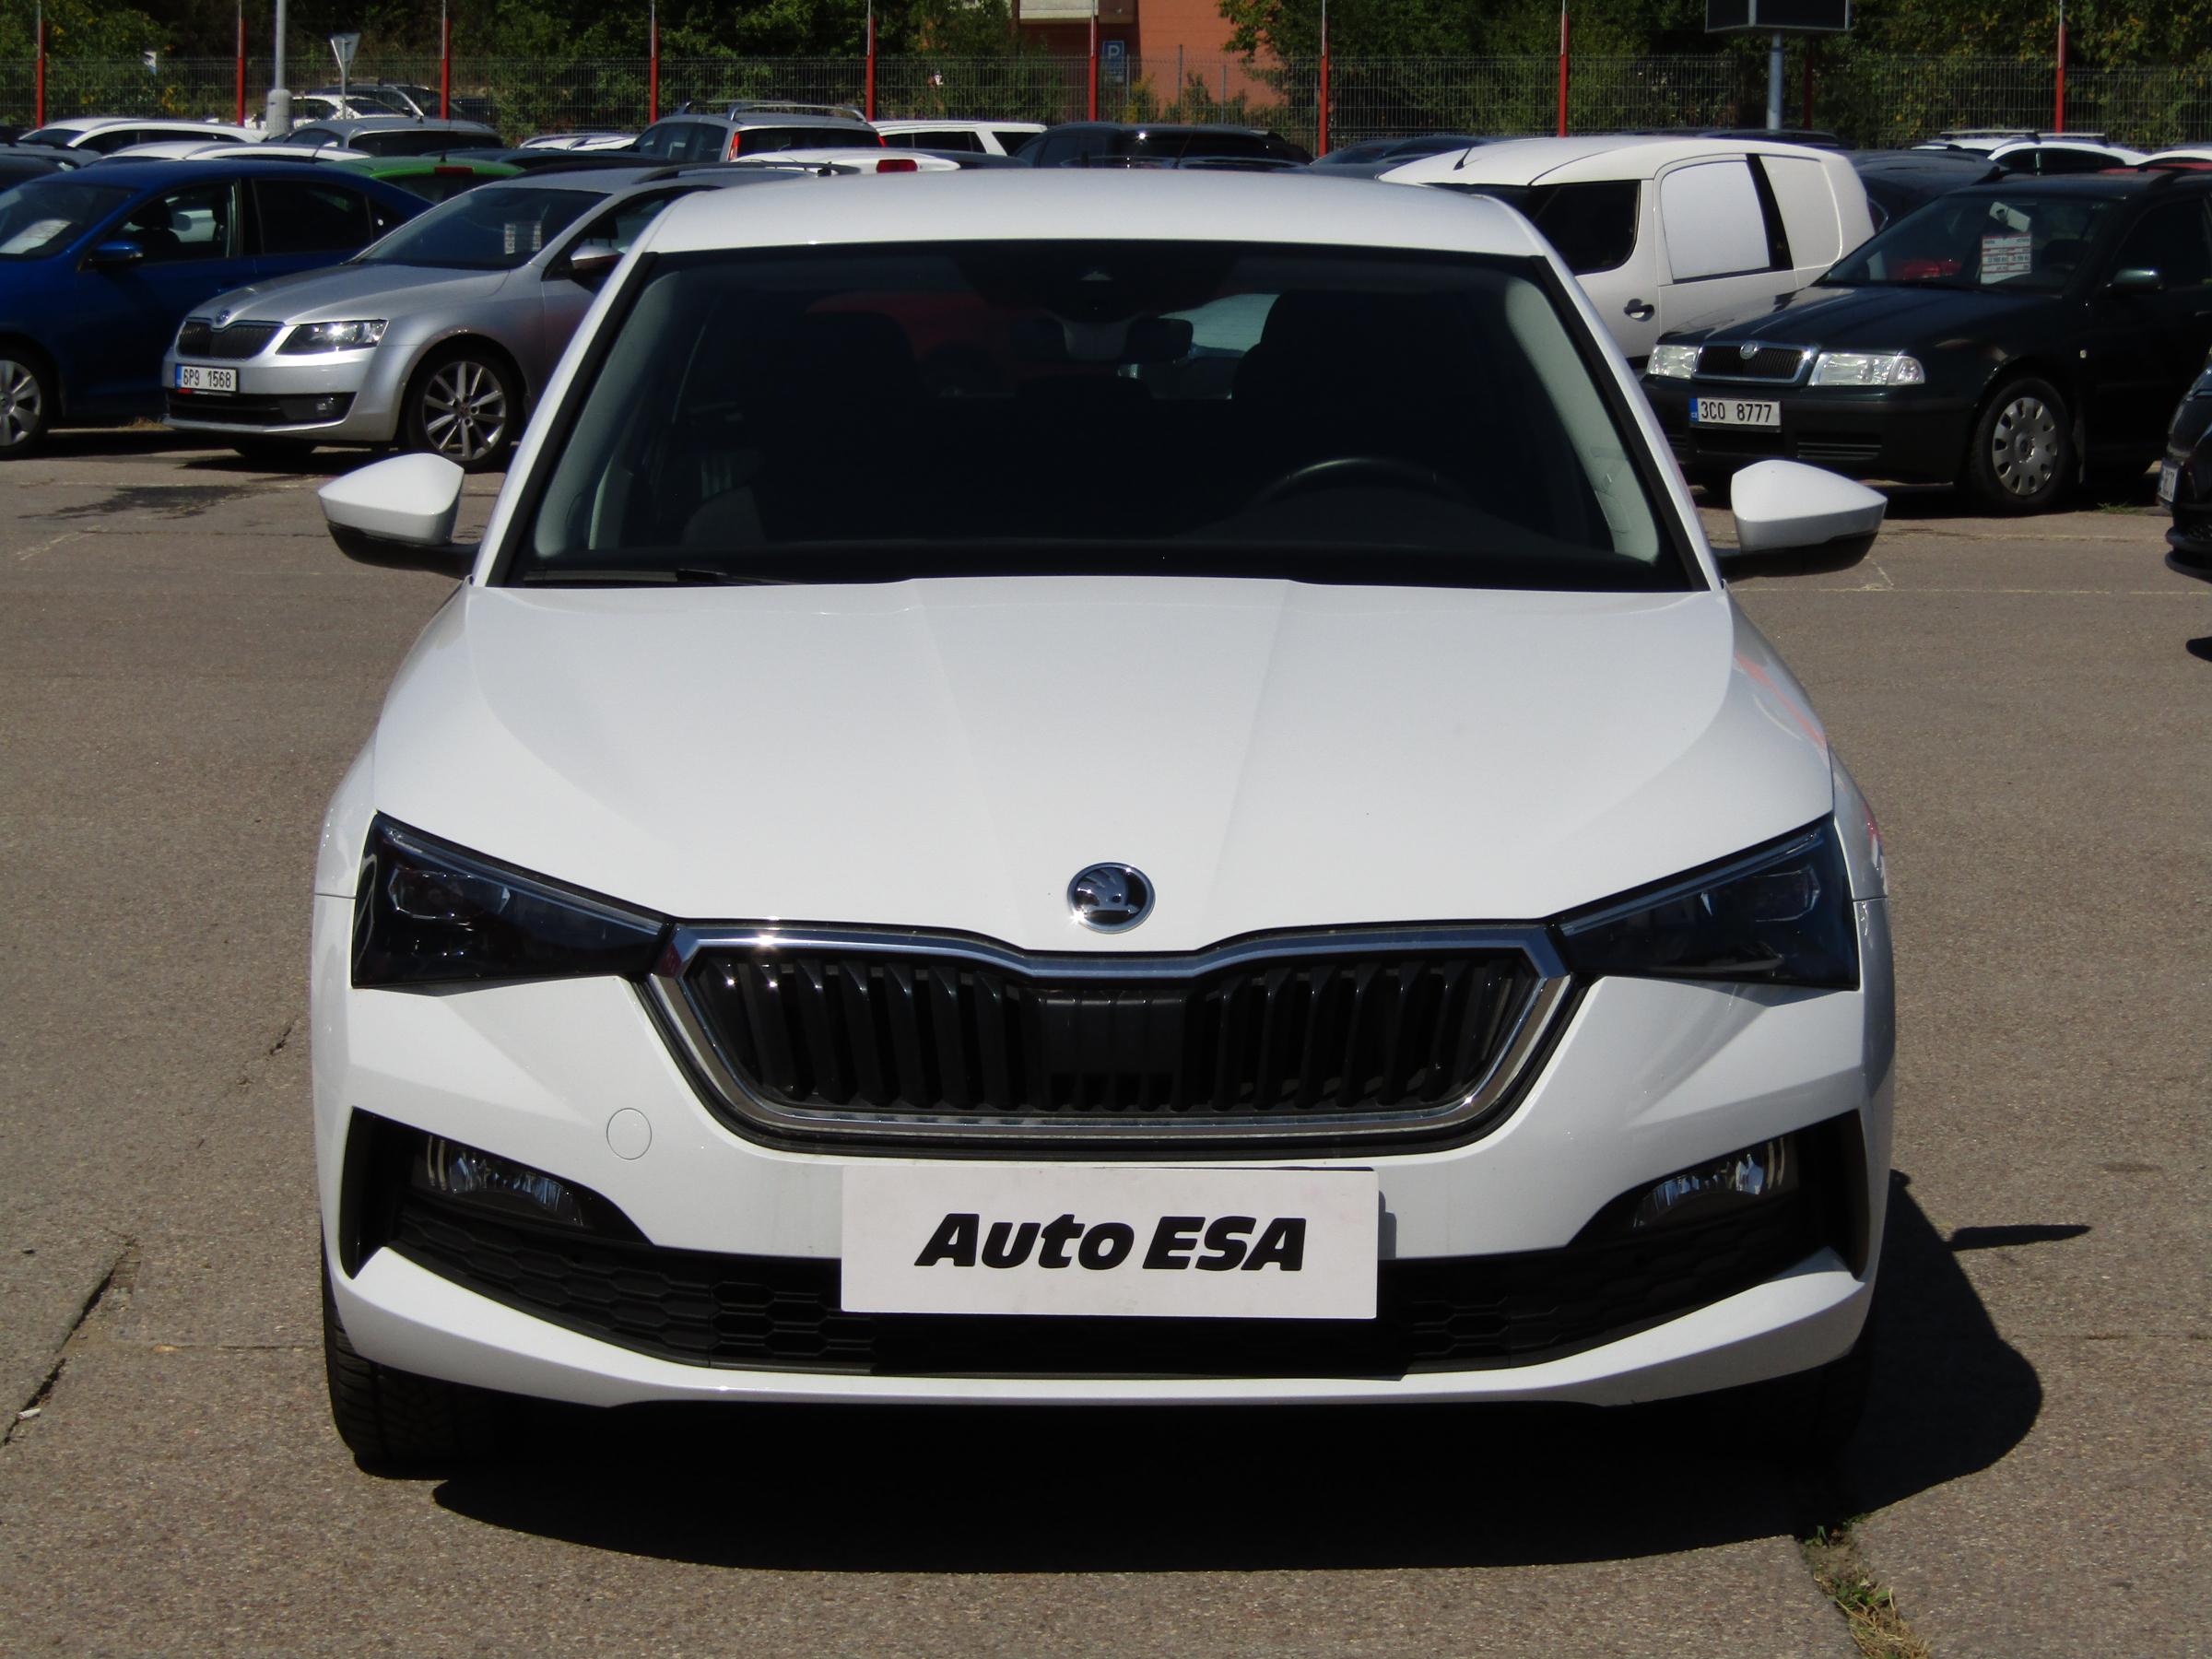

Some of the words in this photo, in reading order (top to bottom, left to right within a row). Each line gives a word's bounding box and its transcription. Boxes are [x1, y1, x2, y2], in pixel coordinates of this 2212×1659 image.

[1108, 44, 1121, 60] P
[183, 369, 200, 386] 6P9
[207, 371, 231, 388] 1568
[1736, 403, 1772, 423] 8777
[914, 1213, 1135, 1270] Auto
[1142, 1216, 1307, 1272] ESA
